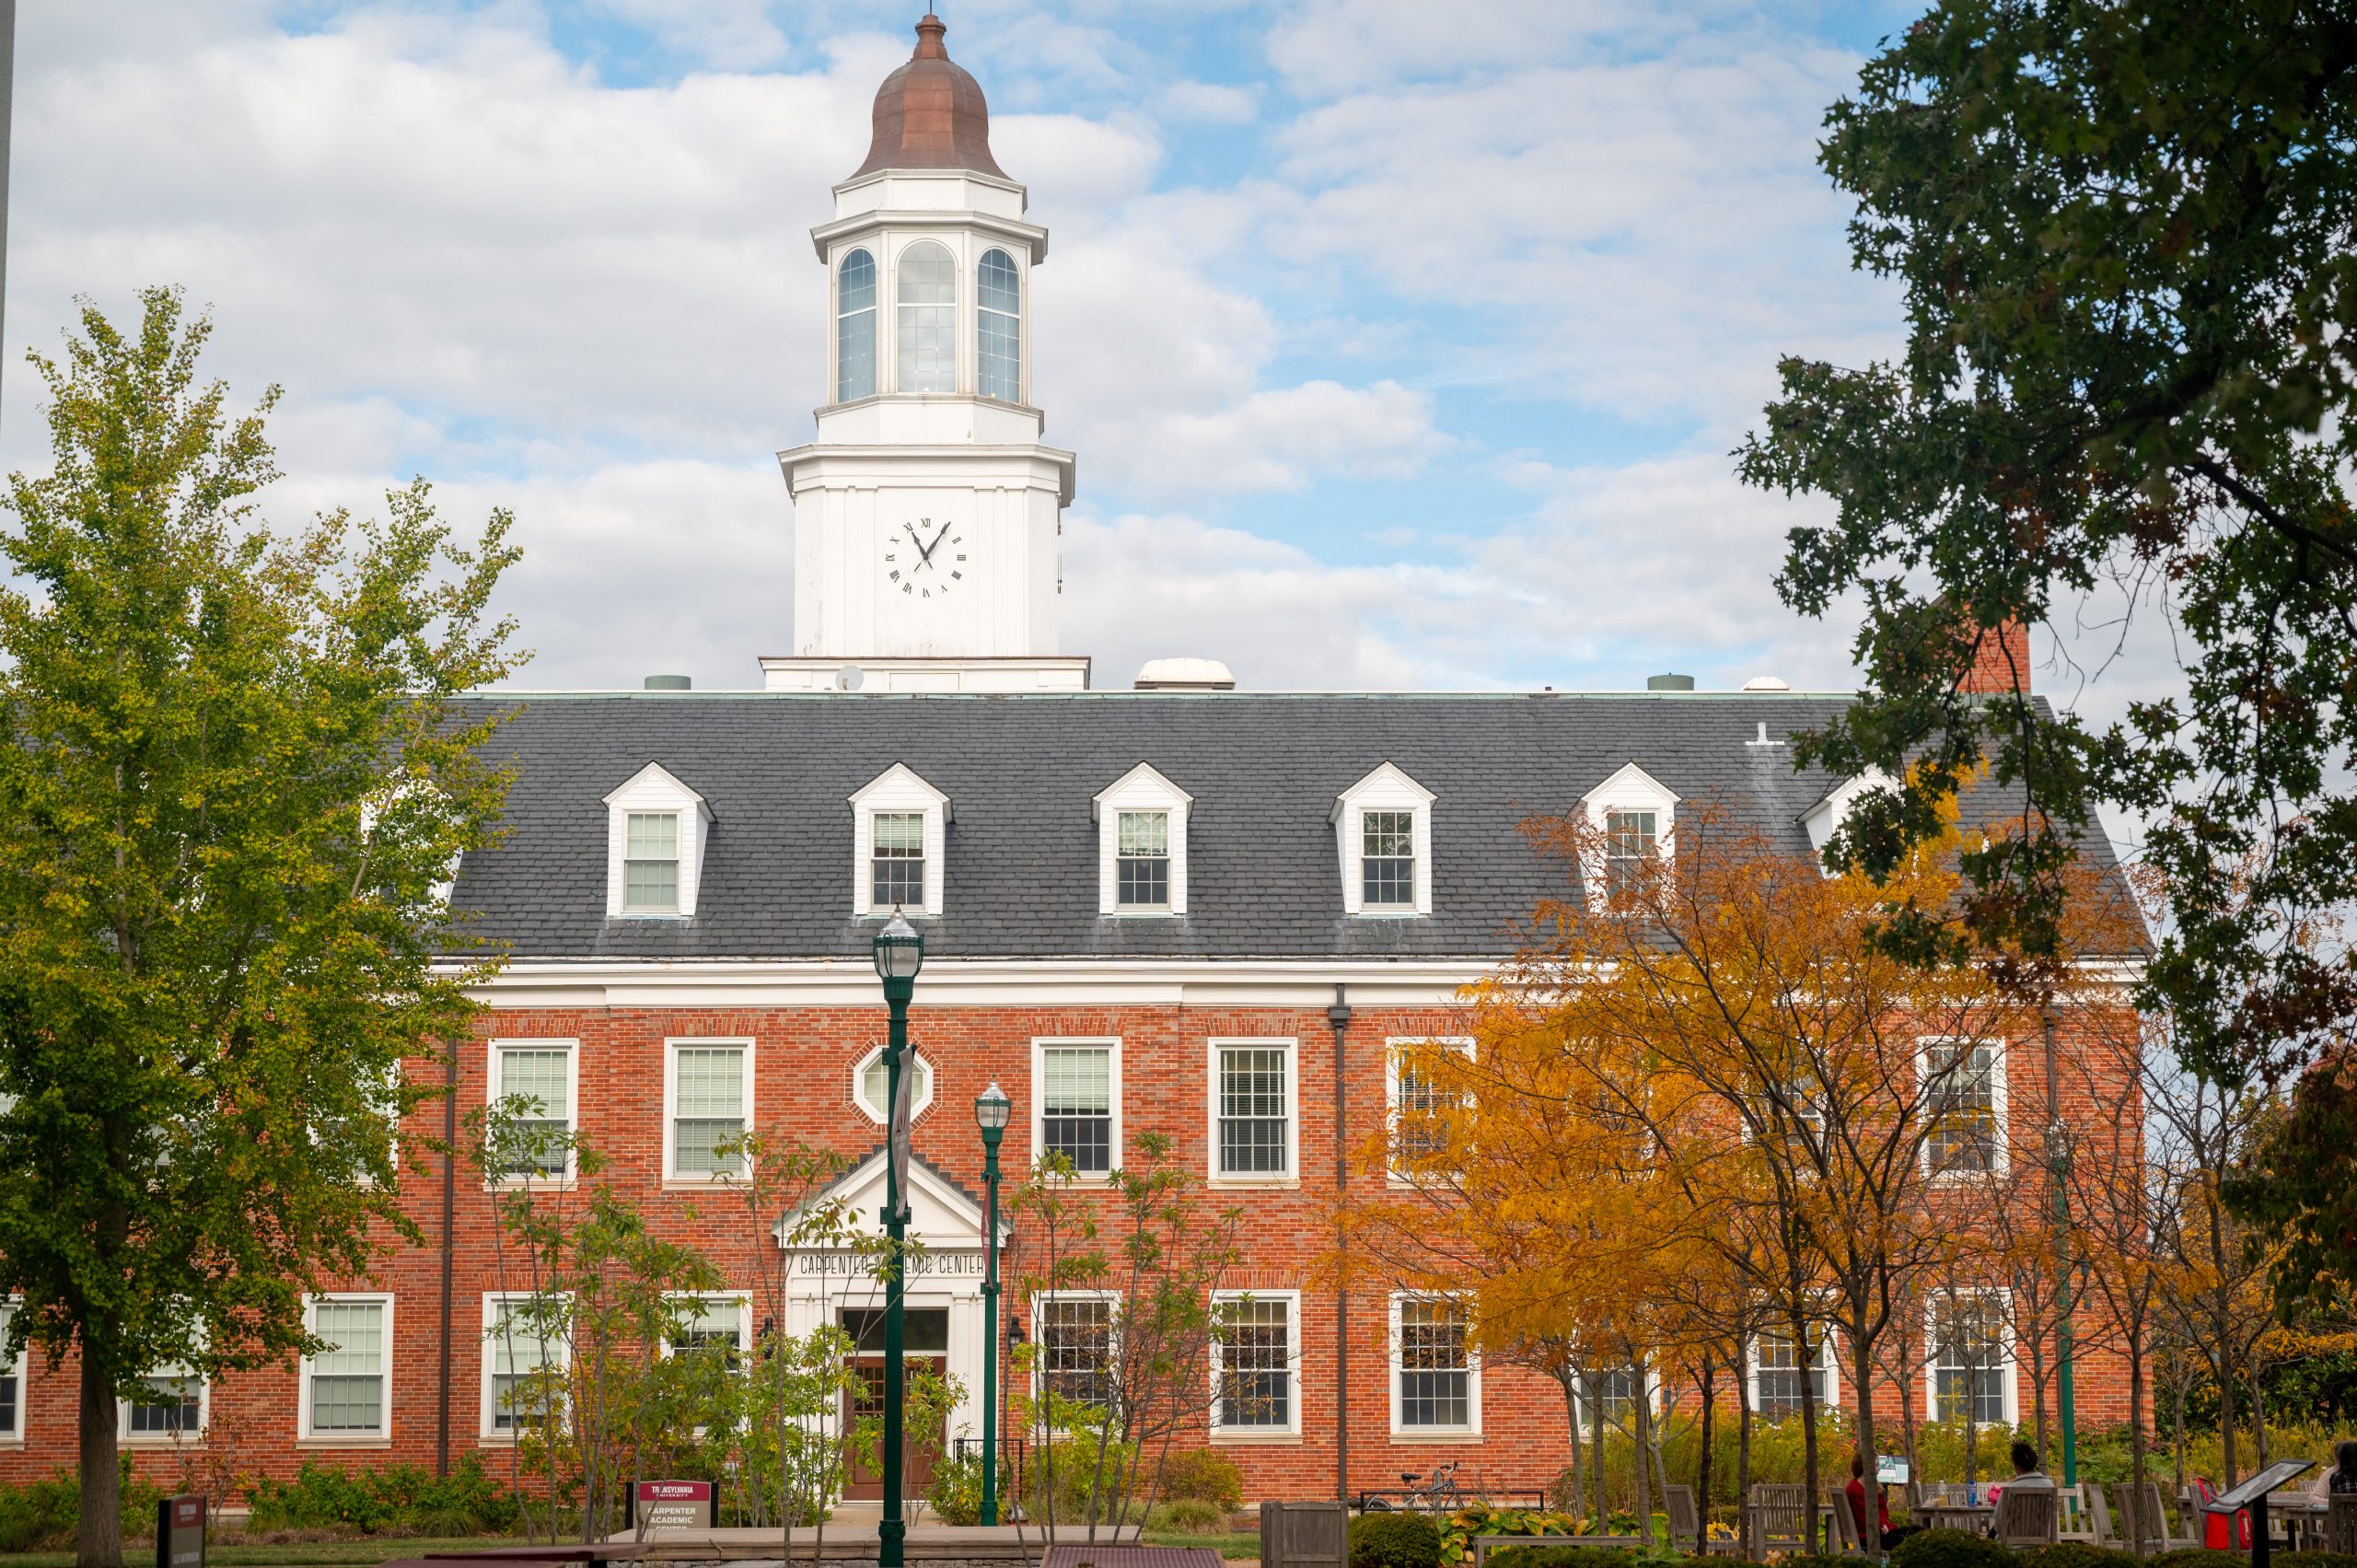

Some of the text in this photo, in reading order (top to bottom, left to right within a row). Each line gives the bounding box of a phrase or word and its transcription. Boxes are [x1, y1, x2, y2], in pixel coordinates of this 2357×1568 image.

[903, 522, 913, 533] XI
[921, 517, 931, 528] XII
[889, 536, 900, 545] X
[952, 536, 962, 544] II
[886, 553, 895, 562] IX
[889, 569, 900, 583] VIII
[902, 582, 912, 595] VII
[923, 587, 931, 598] VI
[941, 585, 948, 594] V
[800, 1255, 984, 1274] CARPENTER EMIC CENTER
